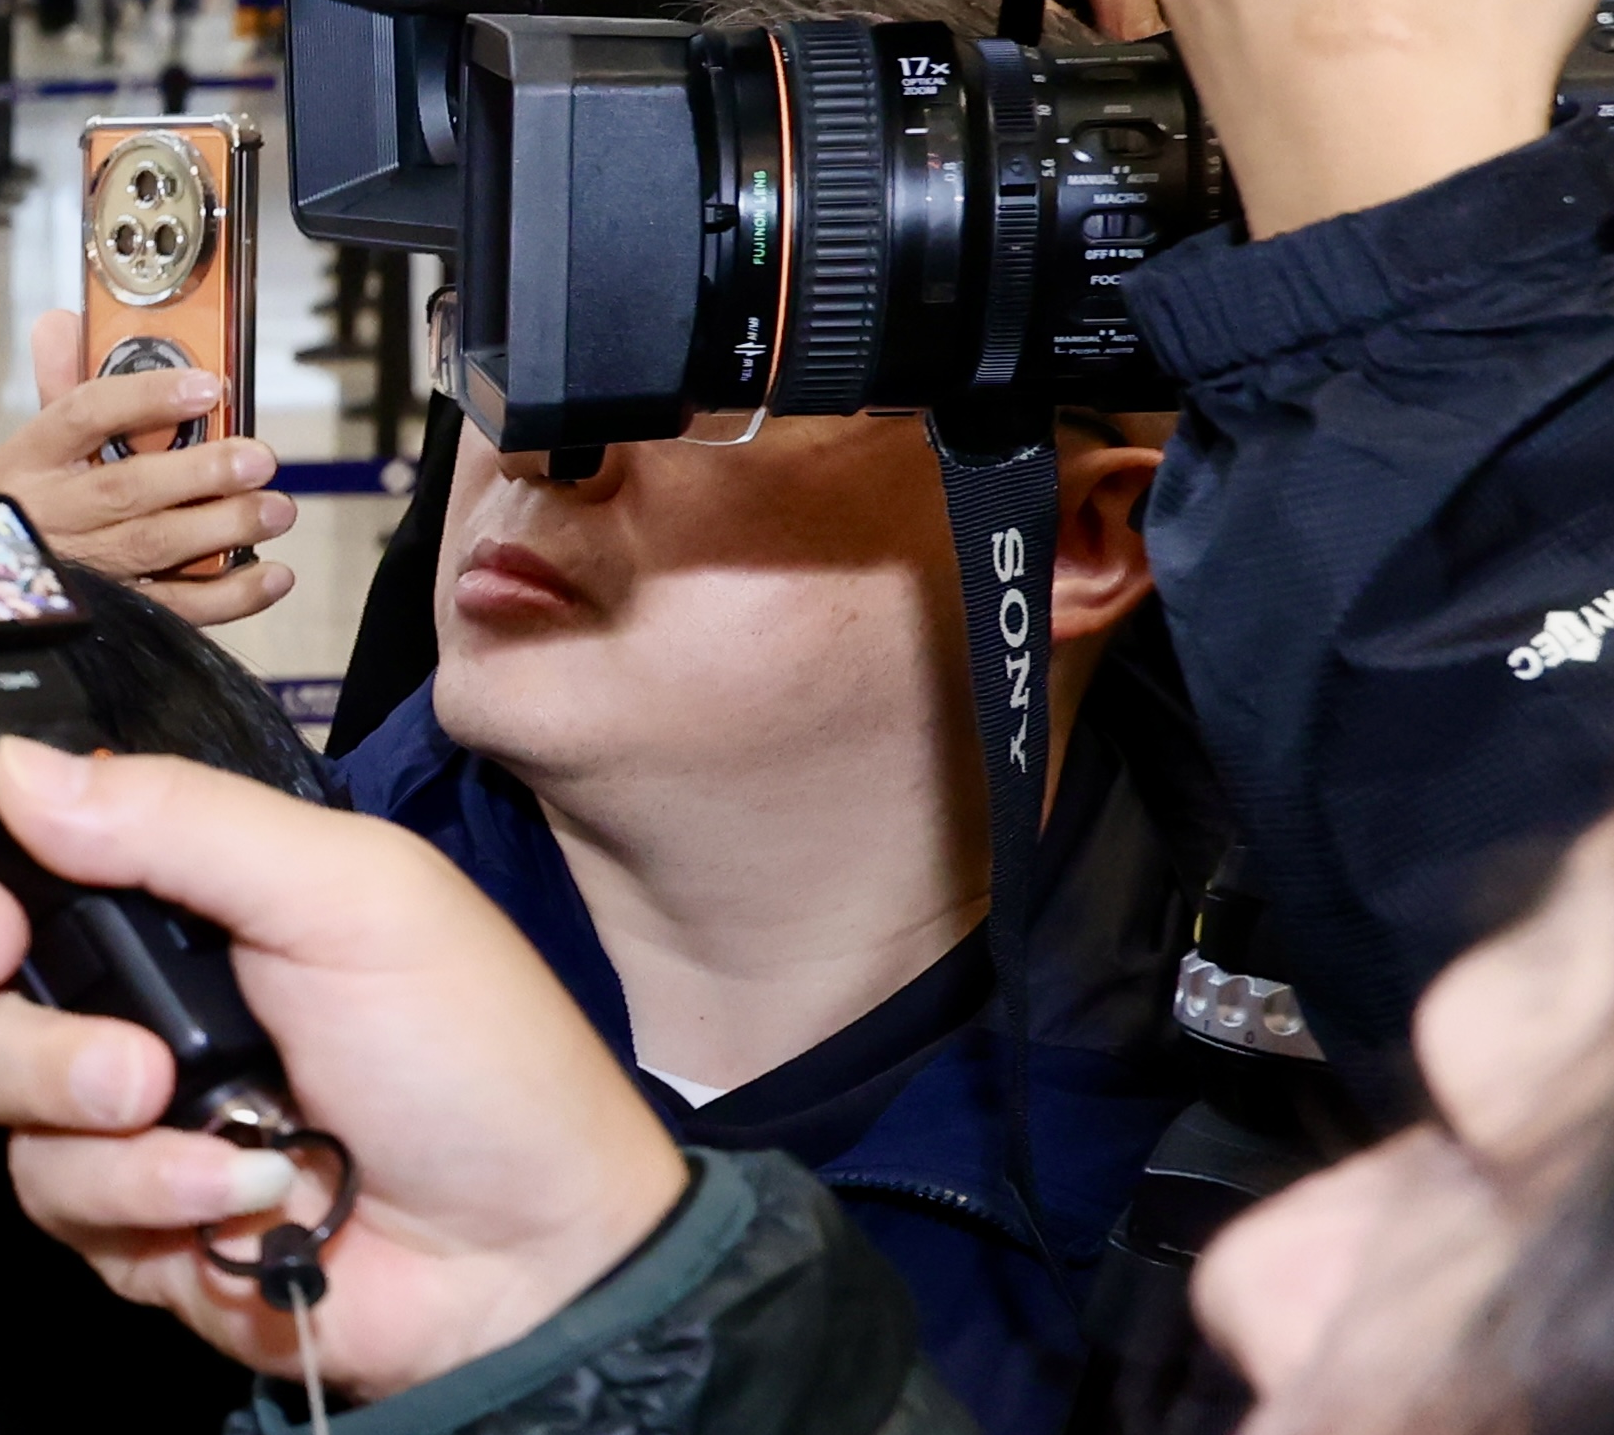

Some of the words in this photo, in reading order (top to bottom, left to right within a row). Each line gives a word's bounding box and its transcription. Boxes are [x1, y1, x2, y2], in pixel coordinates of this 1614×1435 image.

[897, 56, 951, 76] 17x
[901, 76, 947, 87] OPTICAL
[1093, 193, 1148, 204] MACRO
[752, 209, 767, 265] FUJINON
[1090, 274, 1122, 285] FOC
[990, 527, 1031, 773] SONY
